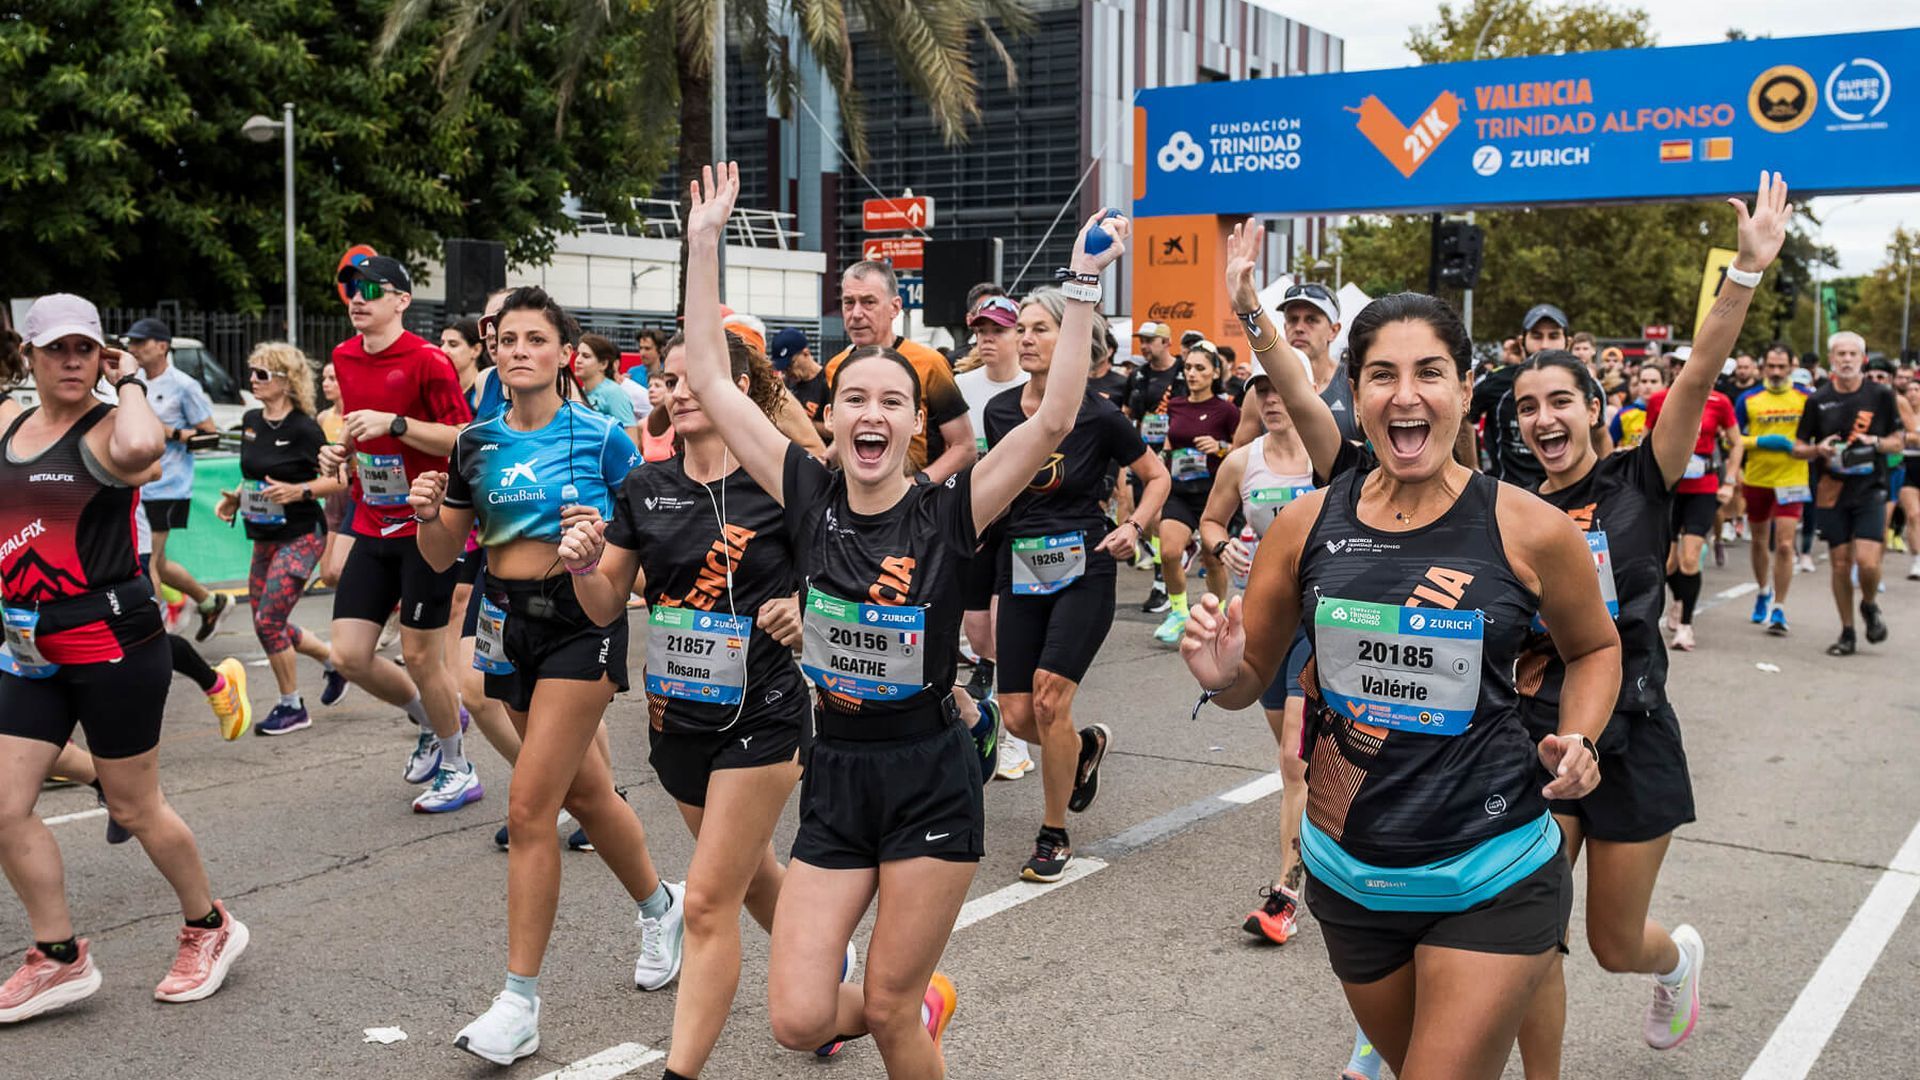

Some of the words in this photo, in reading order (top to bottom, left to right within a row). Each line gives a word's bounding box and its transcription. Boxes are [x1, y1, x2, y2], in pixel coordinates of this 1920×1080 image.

[1838, 78, 1879, 90] SUPER
[1475, 79, 1593, 111] VALENCIA
[1211, 118, 1300, 135] FUNDACIÓN
[1475, 112, 1596, 140] TRINIDAD
[1601, 104, 1735, 133] ALFONSO
[1210, 133, 1300, 155] TRINIDAD
[1404, 107, 1449, 163] 21K
[1210, 152, 1300, 173] ALFONSO
[1510, 147, 1590, 168] ZURICH
[1148, 301, 1195, 319] Coca-Cola
[29, 473, 74, 483] METALFIX
[488, 490, 546, 505] CaixaBank
[1031, 553, 1065, 566] 19268
[713, 619, 744, 631] ZURICH
[881, 613, 915, 623] ZURICH
[1349, 617, 1380, 626] ALFONSO
[1350, 611, 1380, 620] TRINIDAD
[1429, 618, 1472, 631] ZURICH
[667, 634, 716, 656] 21857
[829, 627, 888, 651] 20156
[598, 637, 610, 664] FILA
[1358, 640, 1434, 669] 20185
[667, 661, 711, 680] Rosana
[830, 655, 887, 678] AGATHE
[1361, 675, 1428, 701] Valérie
